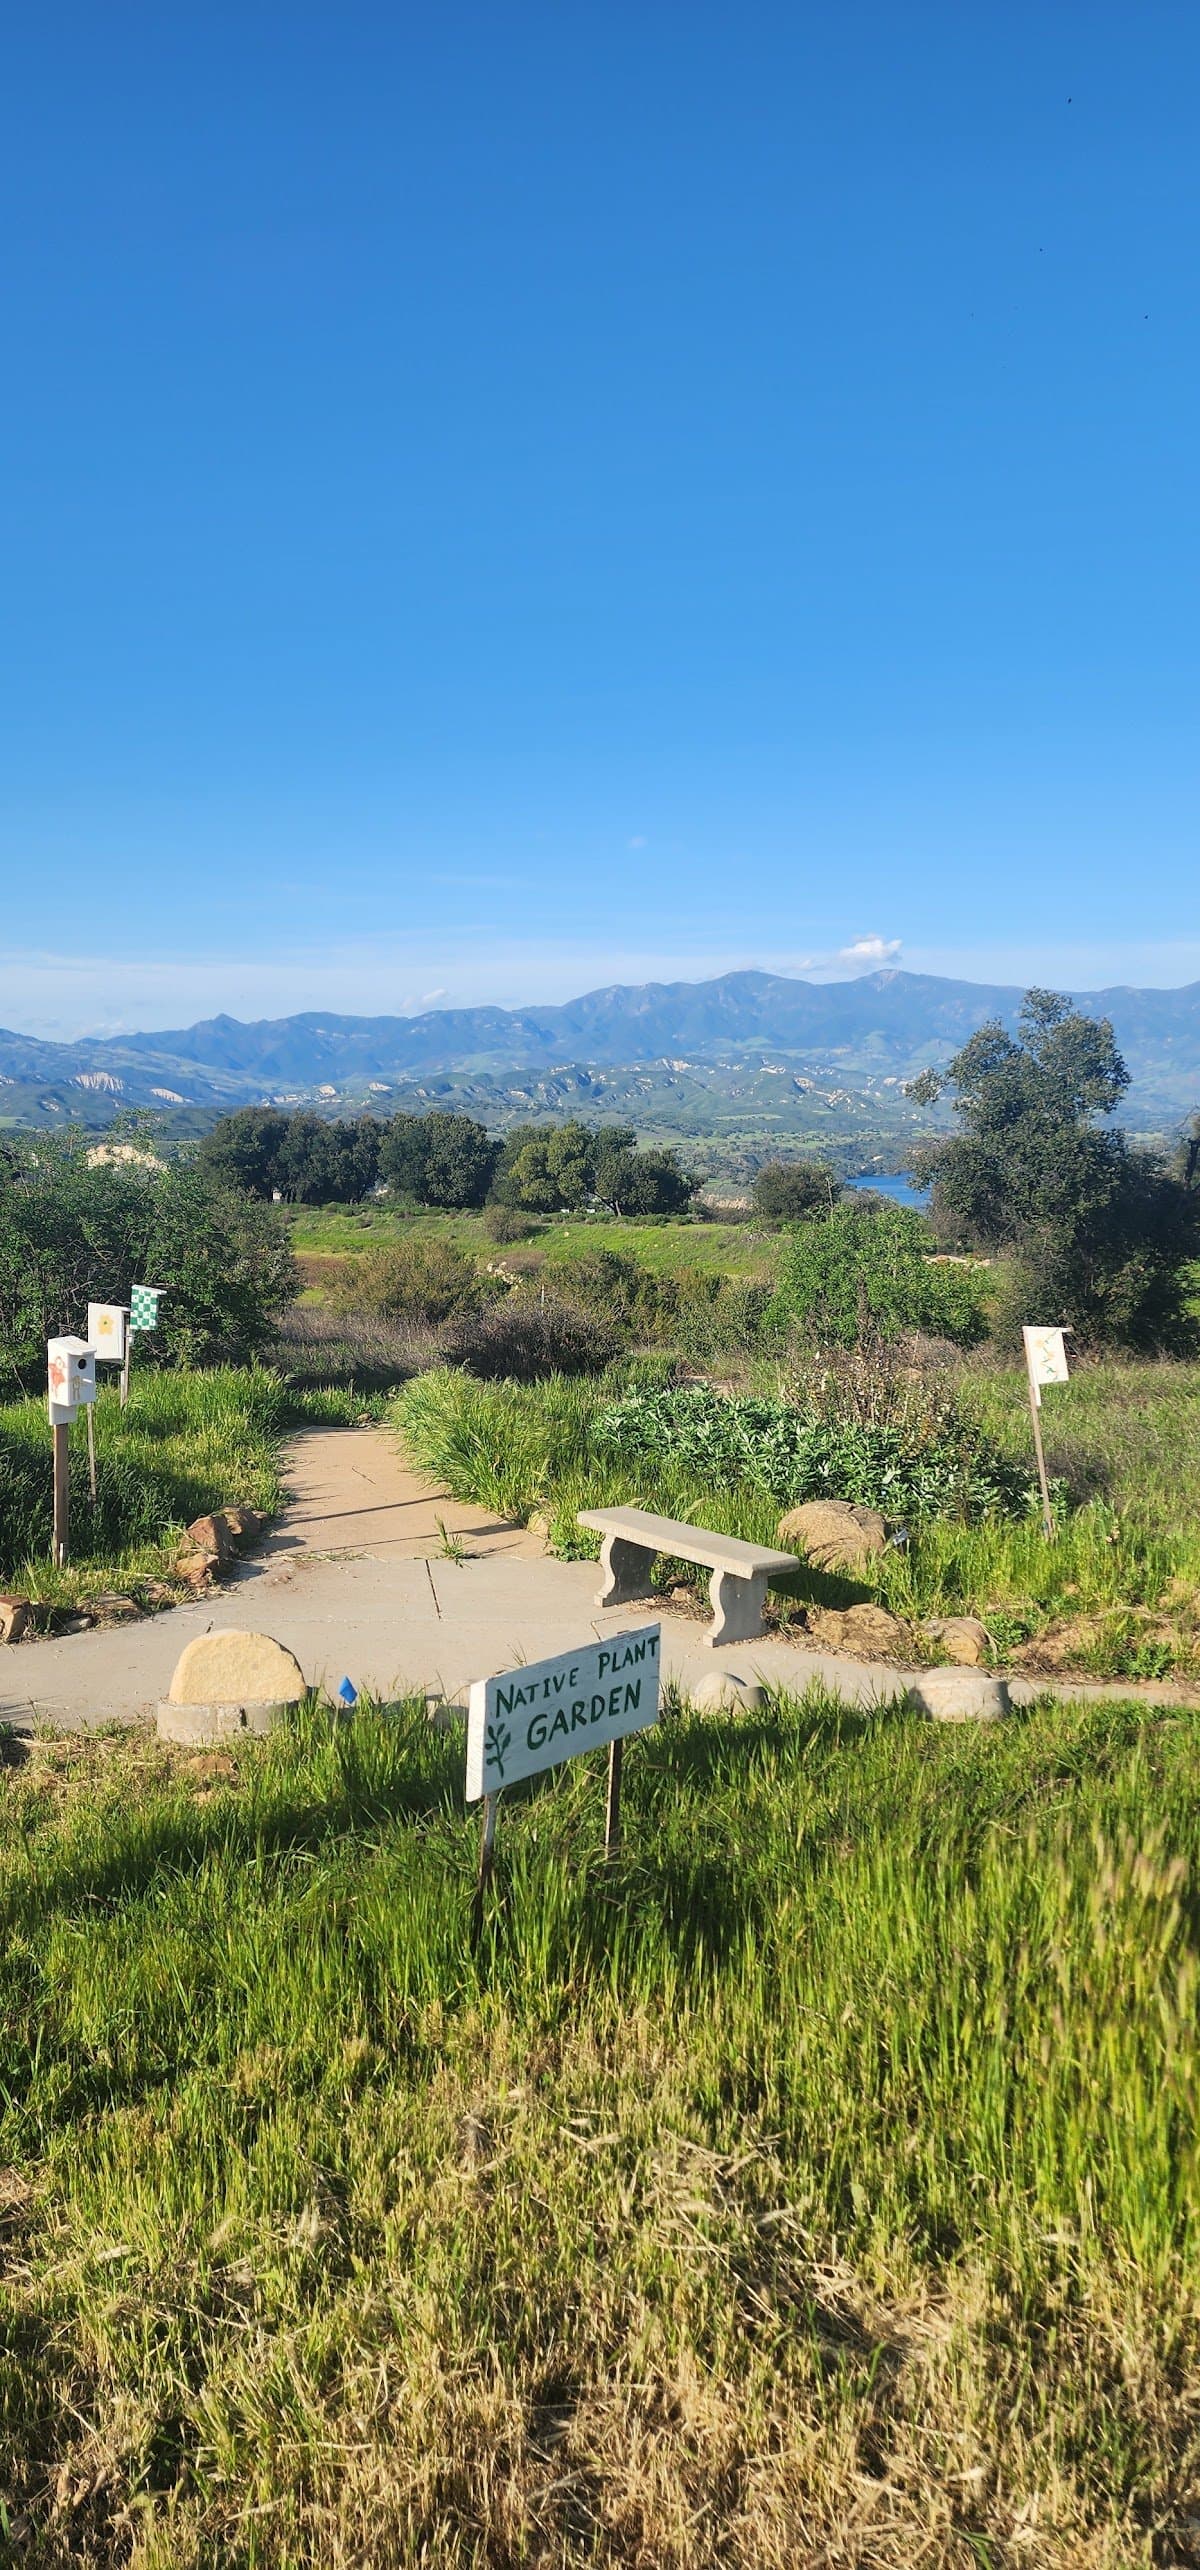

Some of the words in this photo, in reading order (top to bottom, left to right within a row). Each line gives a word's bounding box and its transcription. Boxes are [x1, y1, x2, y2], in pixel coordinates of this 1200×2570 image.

[496, 1667, 579, 1719] NATIVE
[598, 1635, 659, 1679] PLANT
[527, 1679, 641, 1750] GARDEN
